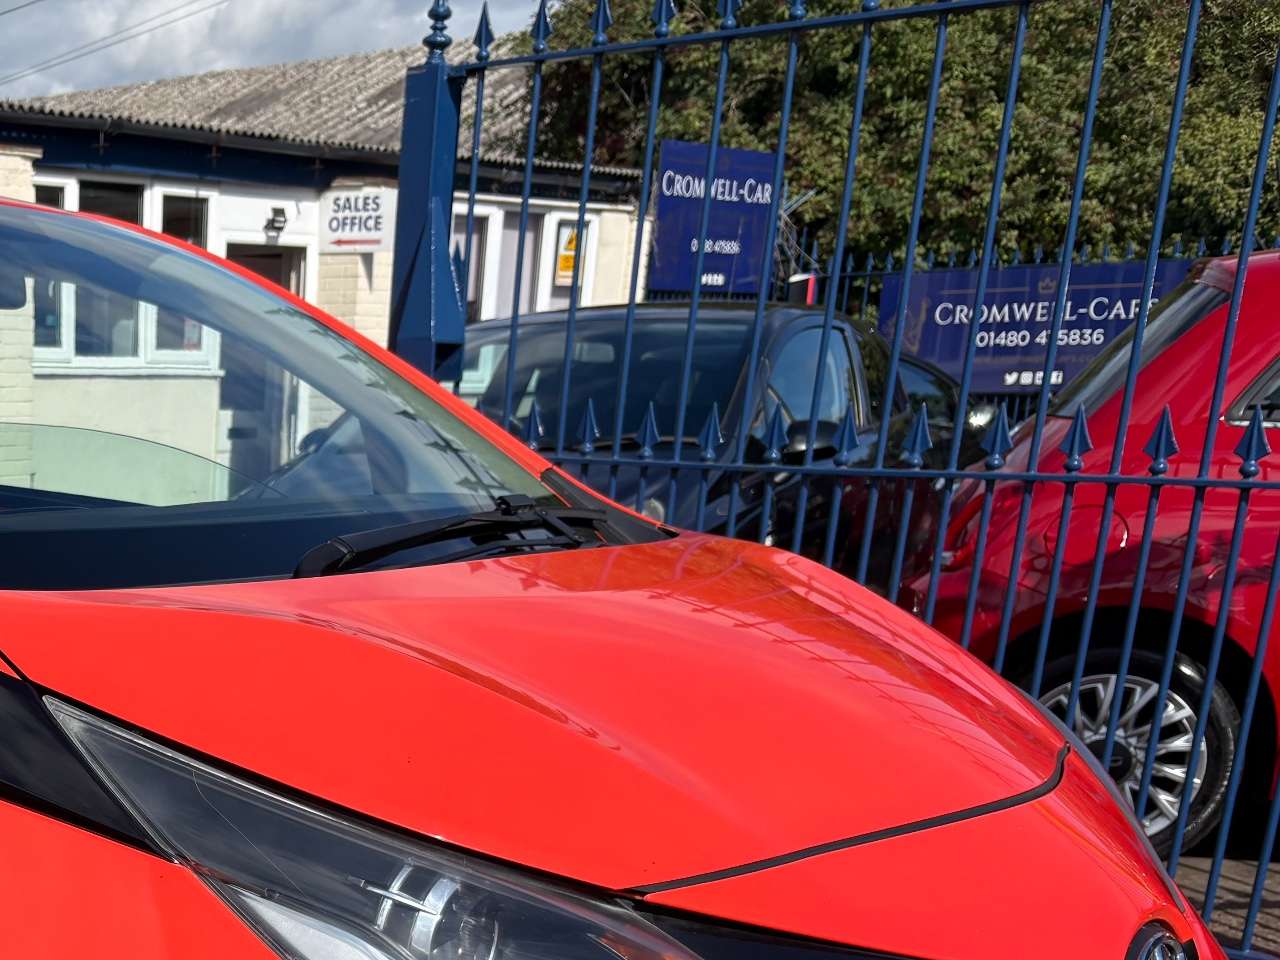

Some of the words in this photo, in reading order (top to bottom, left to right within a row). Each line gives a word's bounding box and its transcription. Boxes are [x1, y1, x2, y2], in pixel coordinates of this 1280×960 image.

[332, 196, 380, 213] SALES
[328, 215, 382, 232] OFFICE
[976, 330, 1031, 347] 01480
[1034, 328, 1105, 346] 45836
